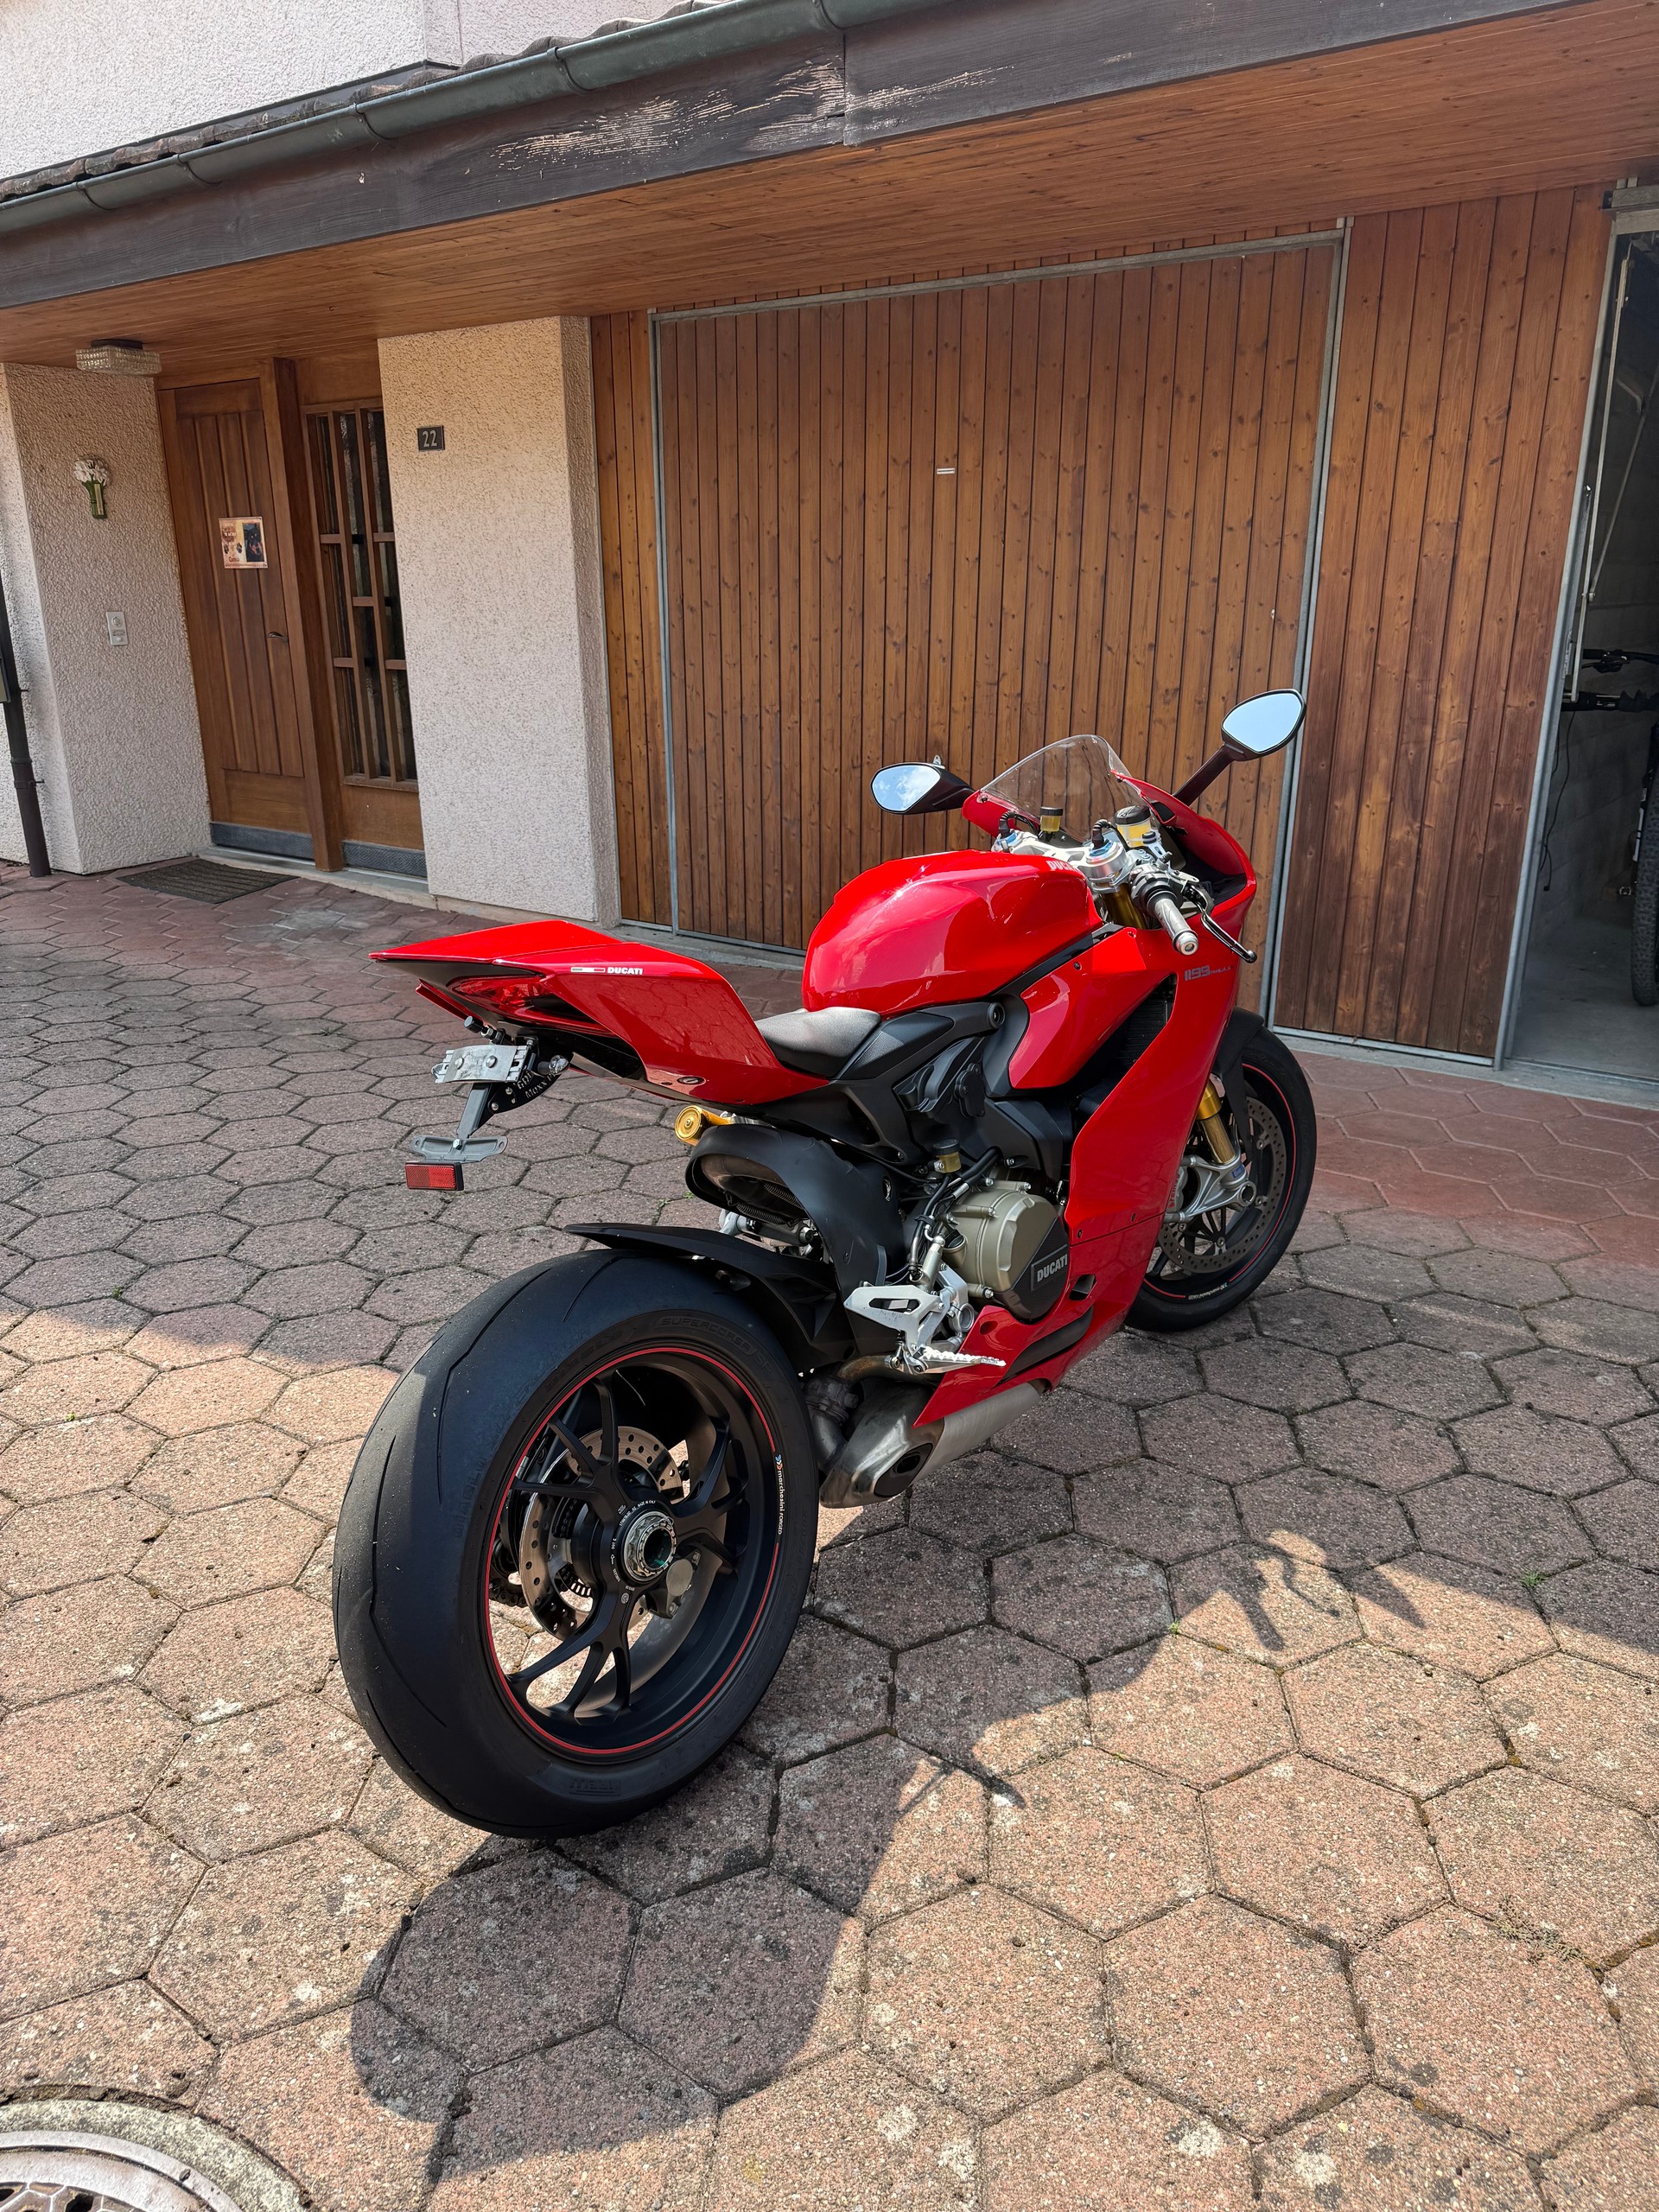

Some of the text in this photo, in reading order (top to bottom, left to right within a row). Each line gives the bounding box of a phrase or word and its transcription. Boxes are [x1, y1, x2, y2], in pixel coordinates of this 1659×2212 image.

[423, 429, 437, 448] 22
[1184, 964, 1211, 982] 1199
[1037, 1254, 1068, 1282] DUCATI
